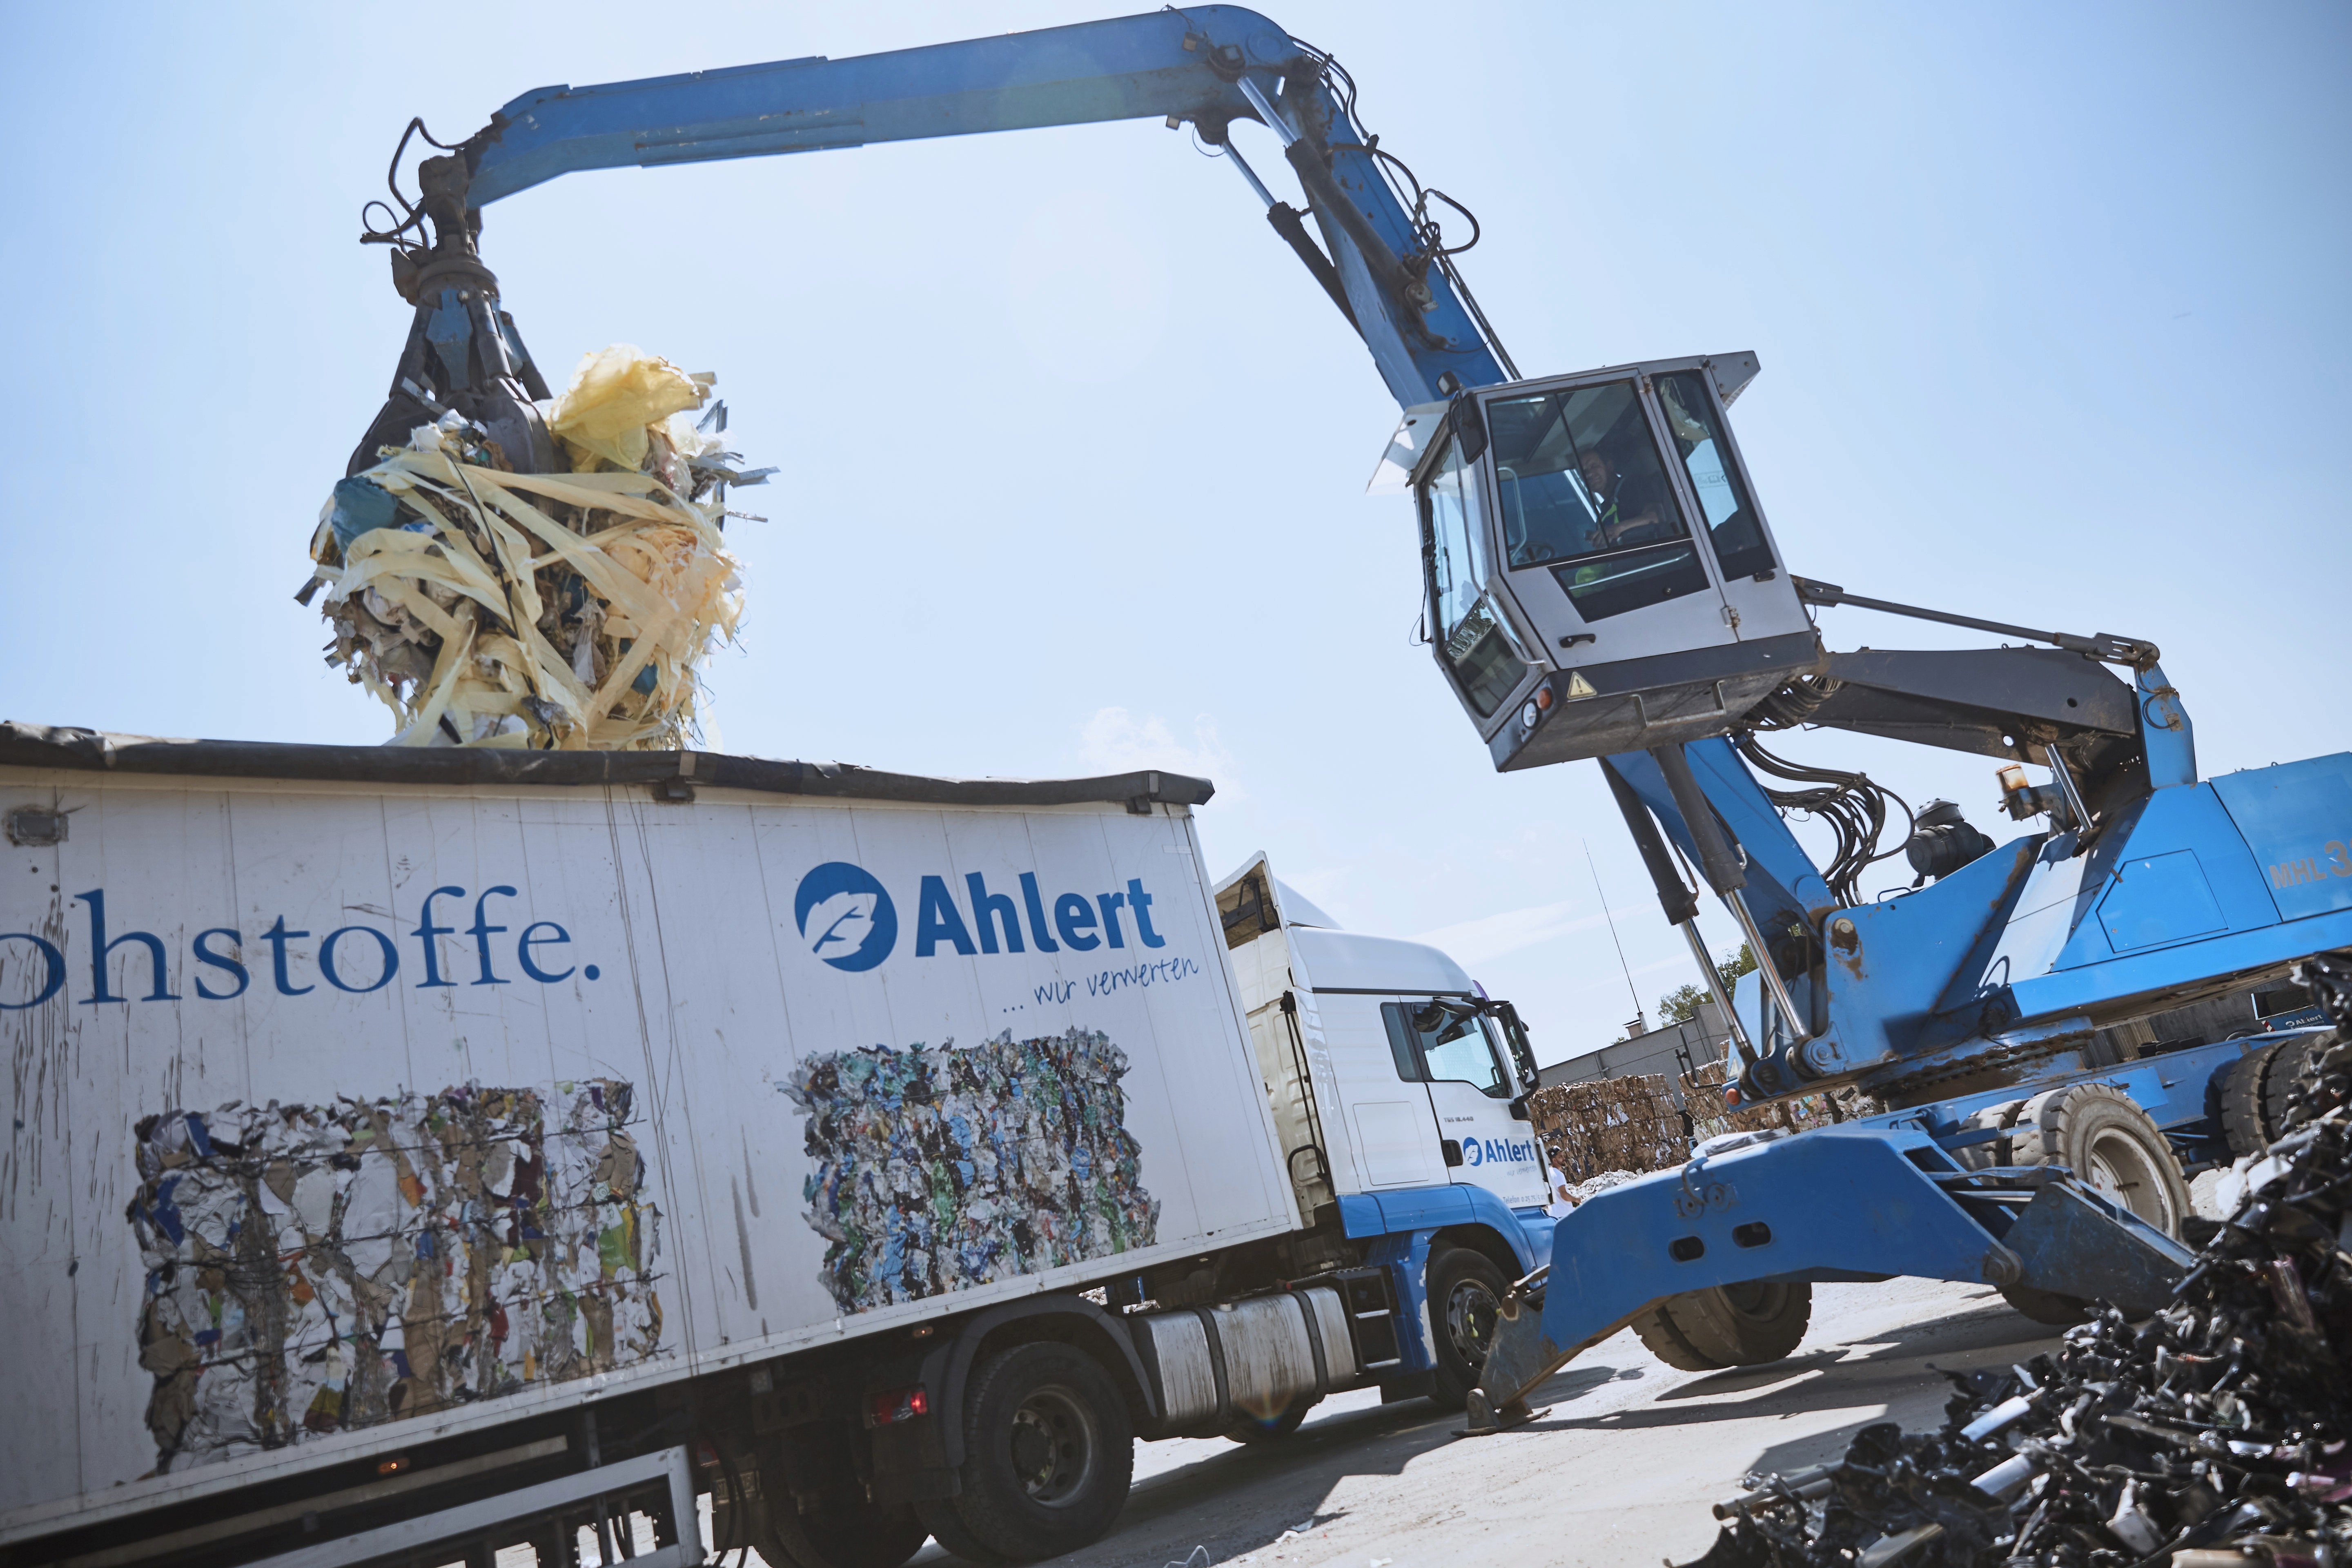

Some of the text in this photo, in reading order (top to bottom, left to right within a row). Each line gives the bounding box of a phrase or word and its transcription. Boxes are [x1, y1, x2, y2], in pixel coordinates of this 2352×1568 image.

[2268, 838, 2352, 889] MHL 3
[915, 871, 1166, 958] Ahlert
[0, 885, 601, 1010] ohstoffe.
[1034, 980, 1076, 1005] wir
[1087, 958, 1199, 997] verwerten
[1486, 1138, 1535, 1163] Ahlert
[1503, 1196, 1519, 1204] Telefon
